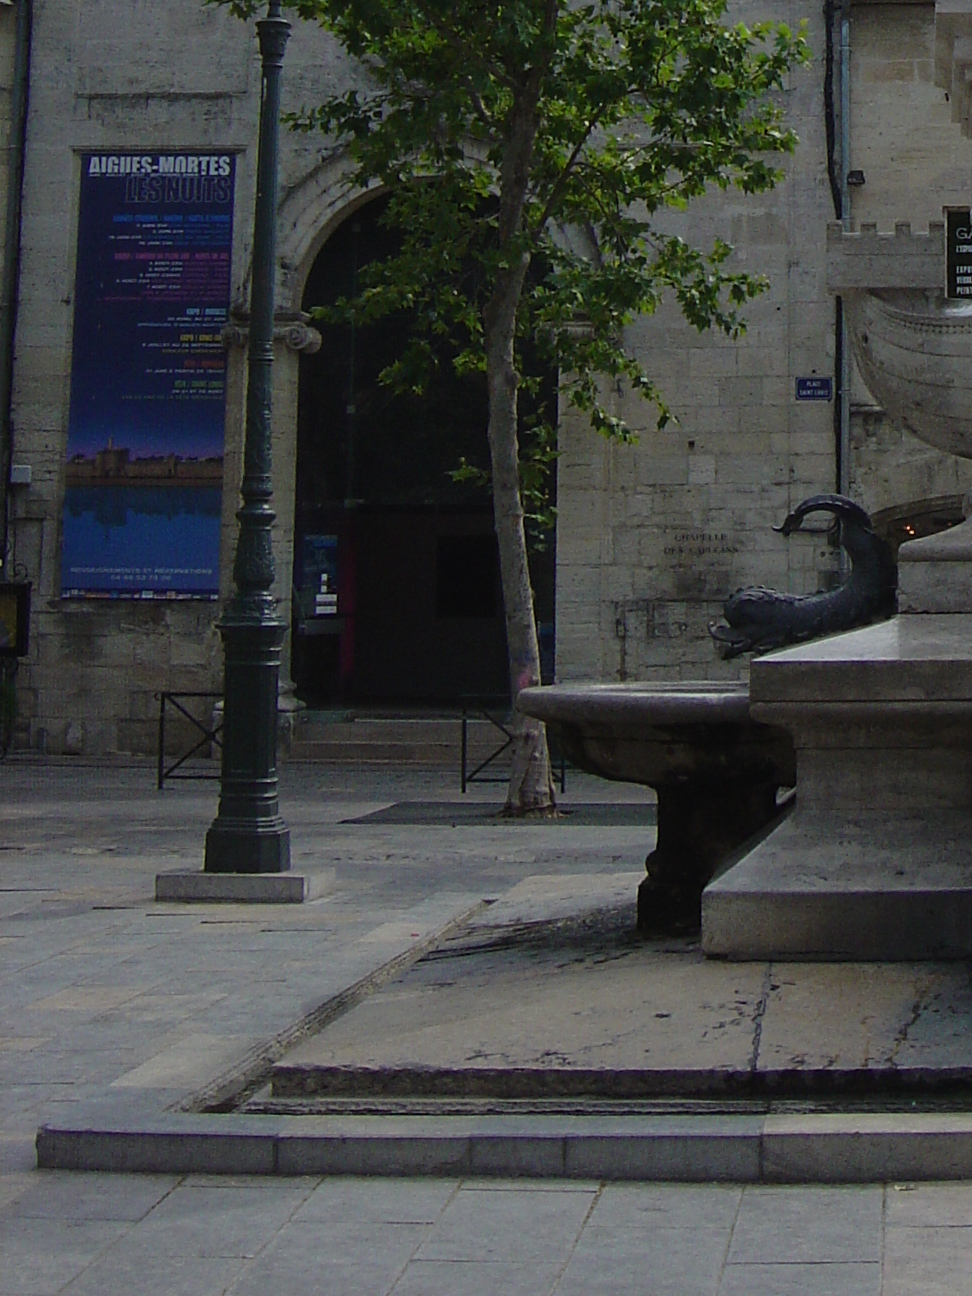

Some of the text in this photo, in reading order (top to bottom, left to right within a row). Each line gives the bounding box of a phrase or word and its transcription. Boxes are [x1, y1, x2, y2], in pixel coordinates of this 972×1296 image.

[89, 155, 231, 176] AIGUES-MORTES
[126, 176, 231, 203] LES NUITS
